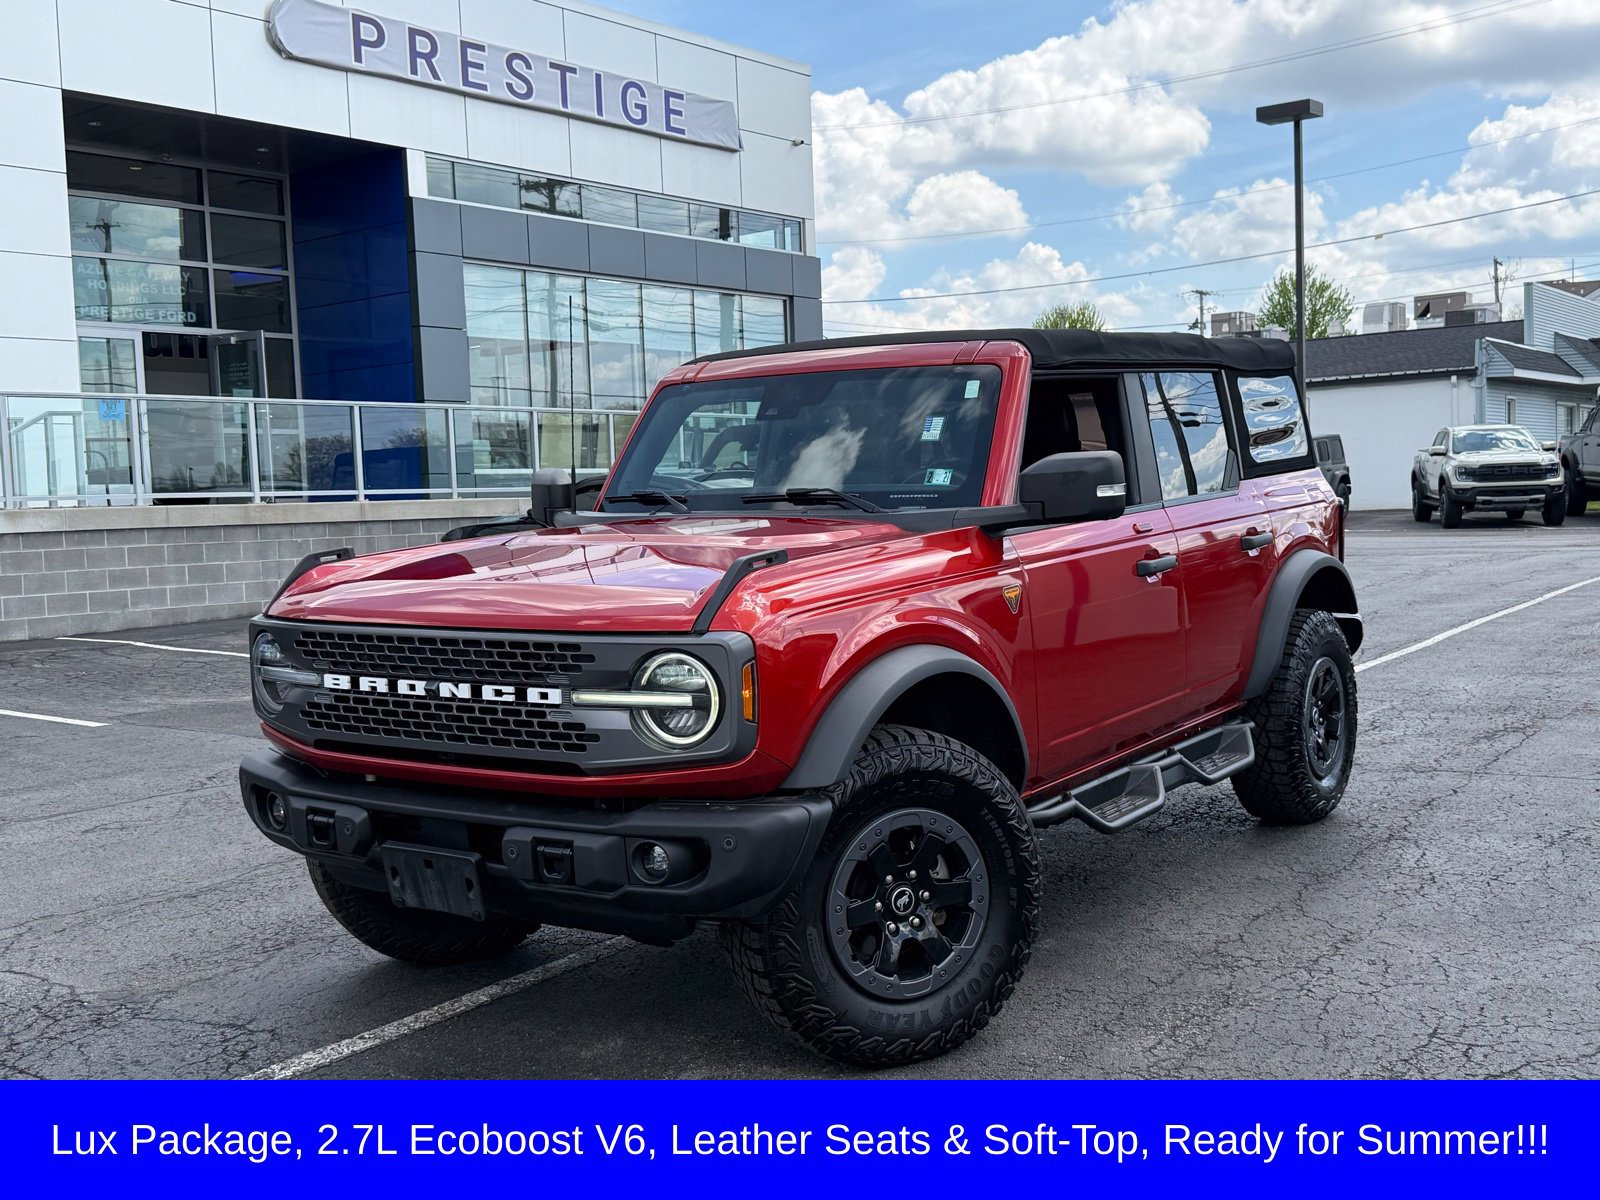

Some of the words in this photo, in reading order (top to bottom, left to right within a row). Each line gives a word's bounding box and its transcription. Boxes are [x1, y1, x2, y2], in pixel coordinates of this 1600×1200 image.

[350, 12, 687, 136] PRESTIGE
[77, 262, 127, 276] AZURE
[129, 265, 190, 281] GATEWAY
[163, 285, 186, 295] LLC
[80, 306, 155, 319] PRESTIGE
[159, 311, 196, 322] FORD
[1475, 467, 1546, 475] FORD
[323, 673, 562, 704] BRONCO
